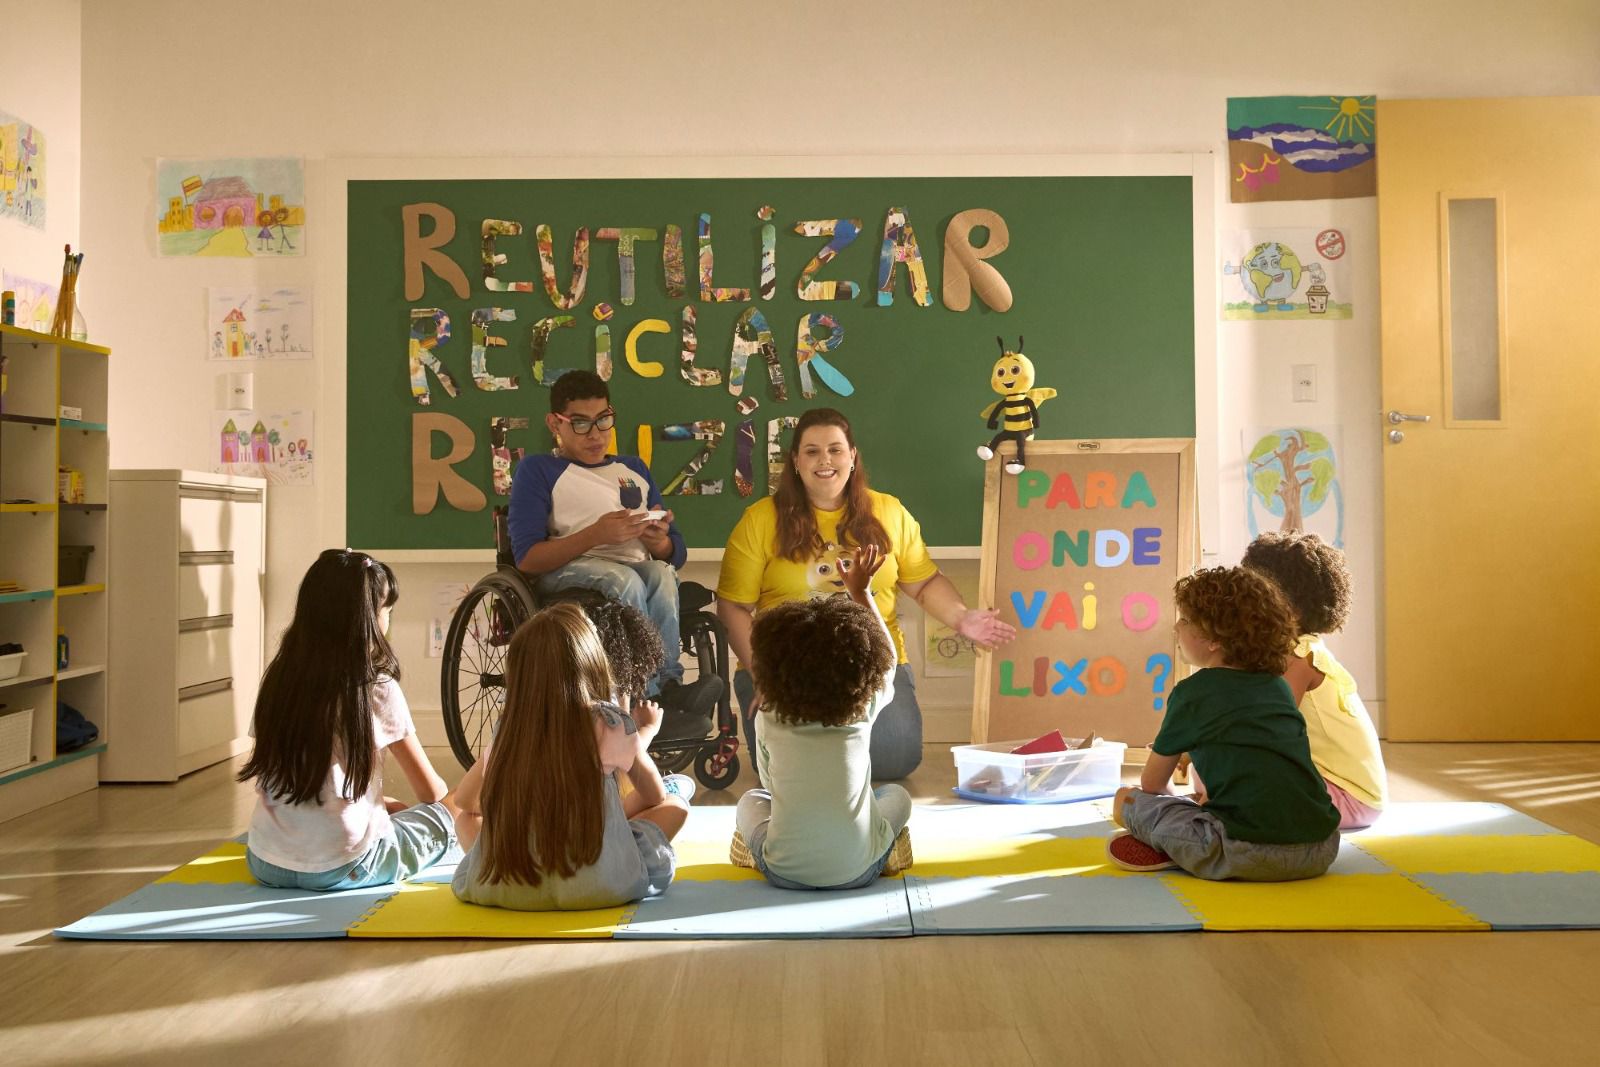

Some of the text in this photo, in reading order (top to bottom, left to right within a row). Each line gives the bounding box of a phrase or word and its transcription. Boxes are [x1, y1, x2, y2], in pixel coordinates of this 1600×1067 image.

[1017, 470, 1157, 509] PARA
[1012, 527, 1162, 571] ONDE
[1121, 592, 1160, 632] O
[999, 656, 1128, 697] LIXO
